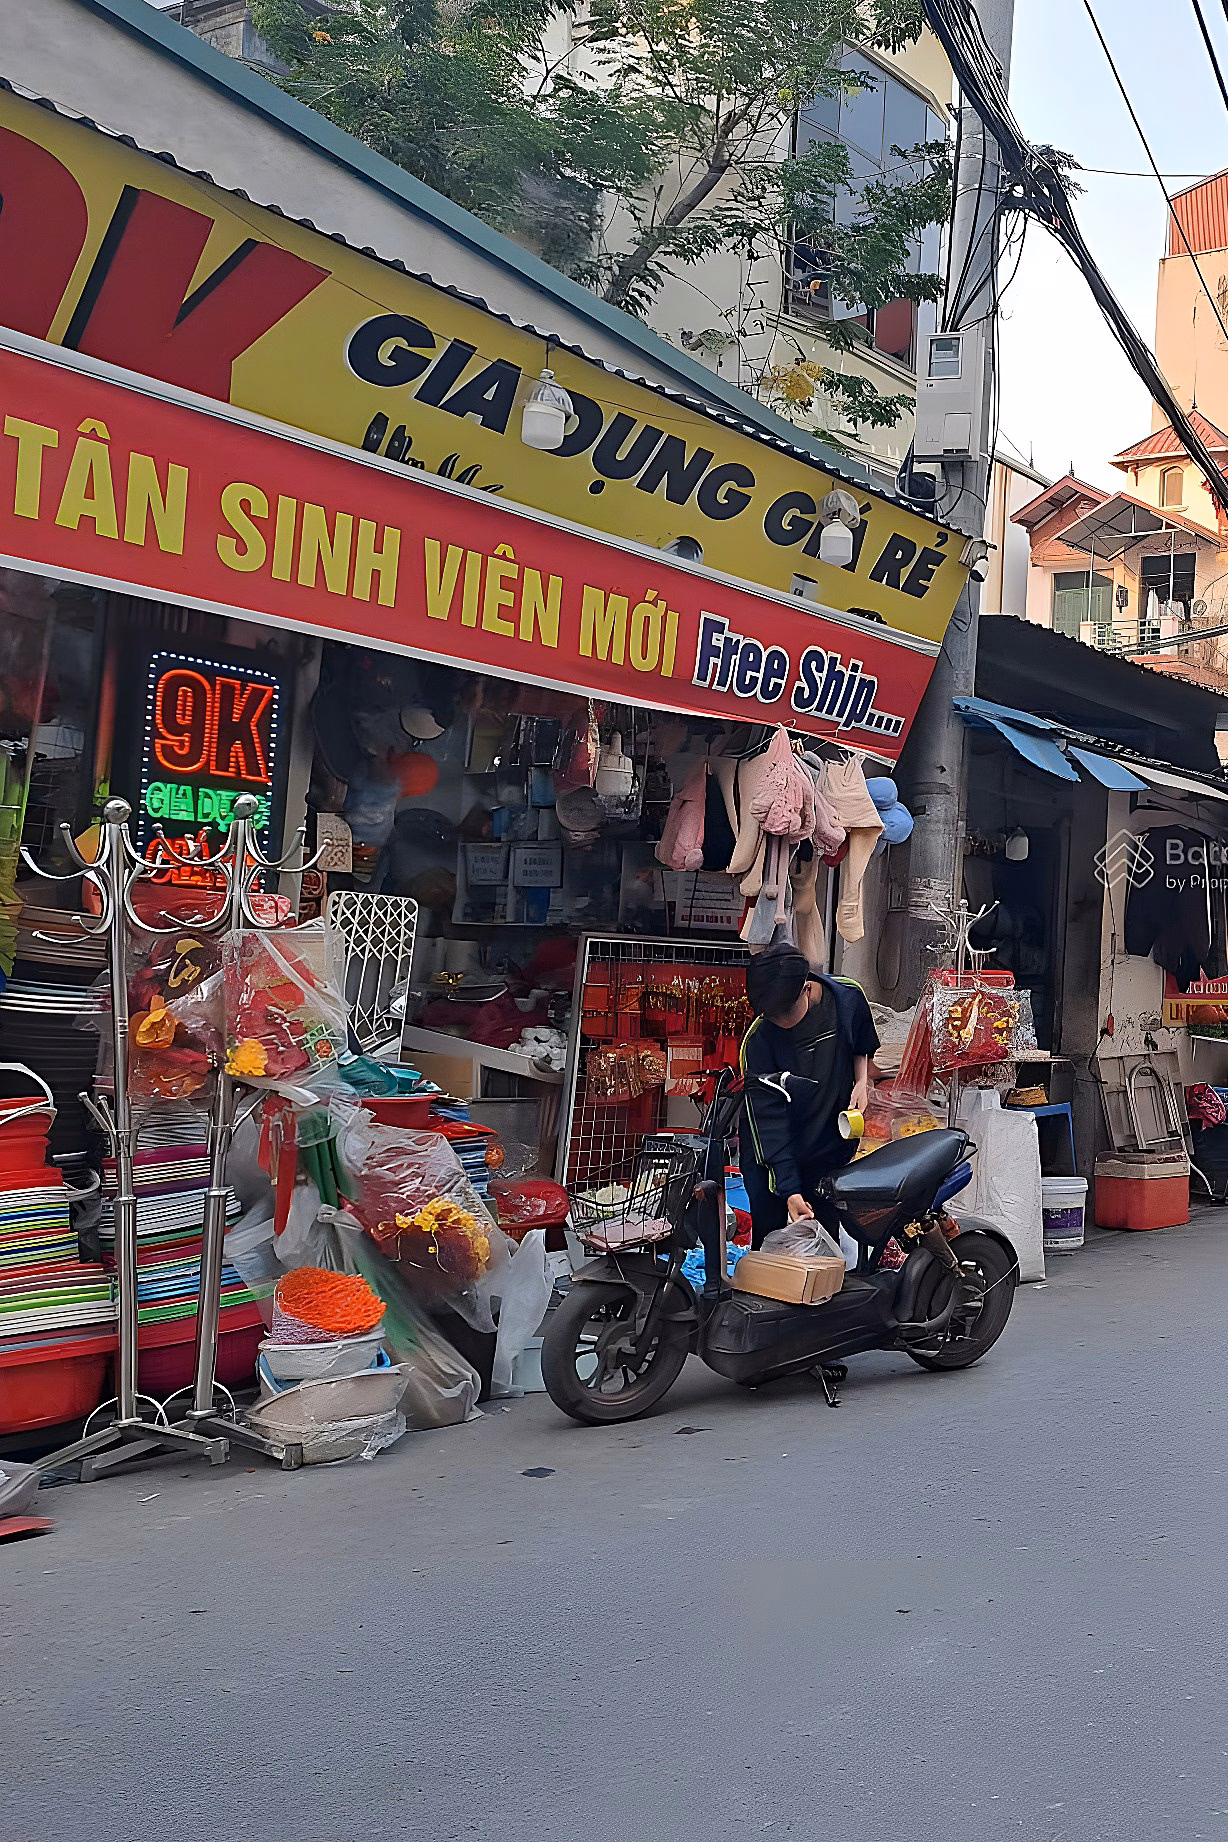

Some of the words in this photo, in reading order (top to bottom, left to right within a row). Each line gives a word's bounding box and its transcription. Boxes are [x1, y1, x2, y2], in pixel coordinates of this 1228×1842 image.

[3, 417, 189, 556] TÂN
[216, 481, 402, 608] SINH
[424, 542, 563, 649] VIÊN
[578, 584, 681, 678] MỚI
[692, 610, 790, 704] Free
[344, 313, 524, 436] GIA
[868, 531, 948, 599] RẺ
[153, 668, 274, 783] 9K
